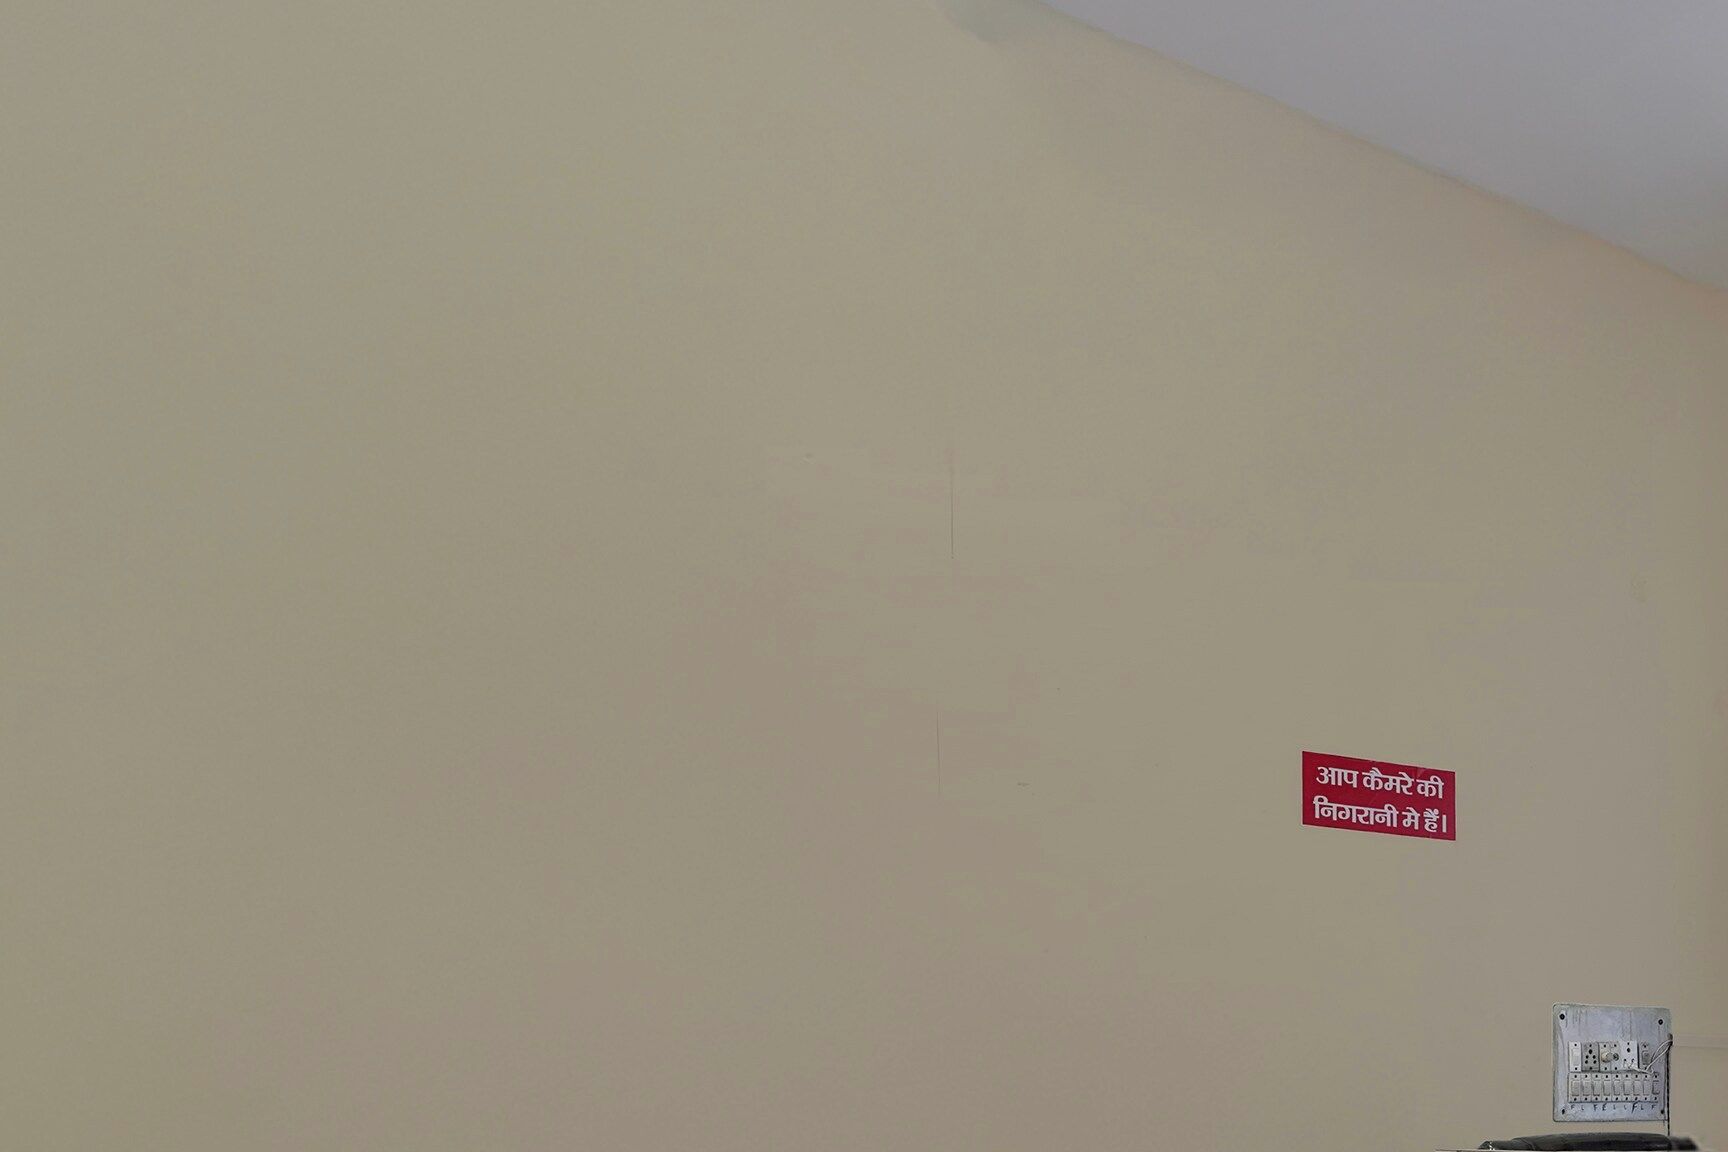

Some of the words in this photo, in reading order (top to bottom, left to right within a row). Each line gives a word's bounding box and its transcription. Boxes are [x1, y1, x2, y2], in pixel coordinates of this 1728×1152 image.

[1316, 766, 1359, 789] आप
[1362, 767, 1414, 796] कैमरे
[1416, 775, 1444, 799] की
[1313, 795, 1399, 828] निगरानी
